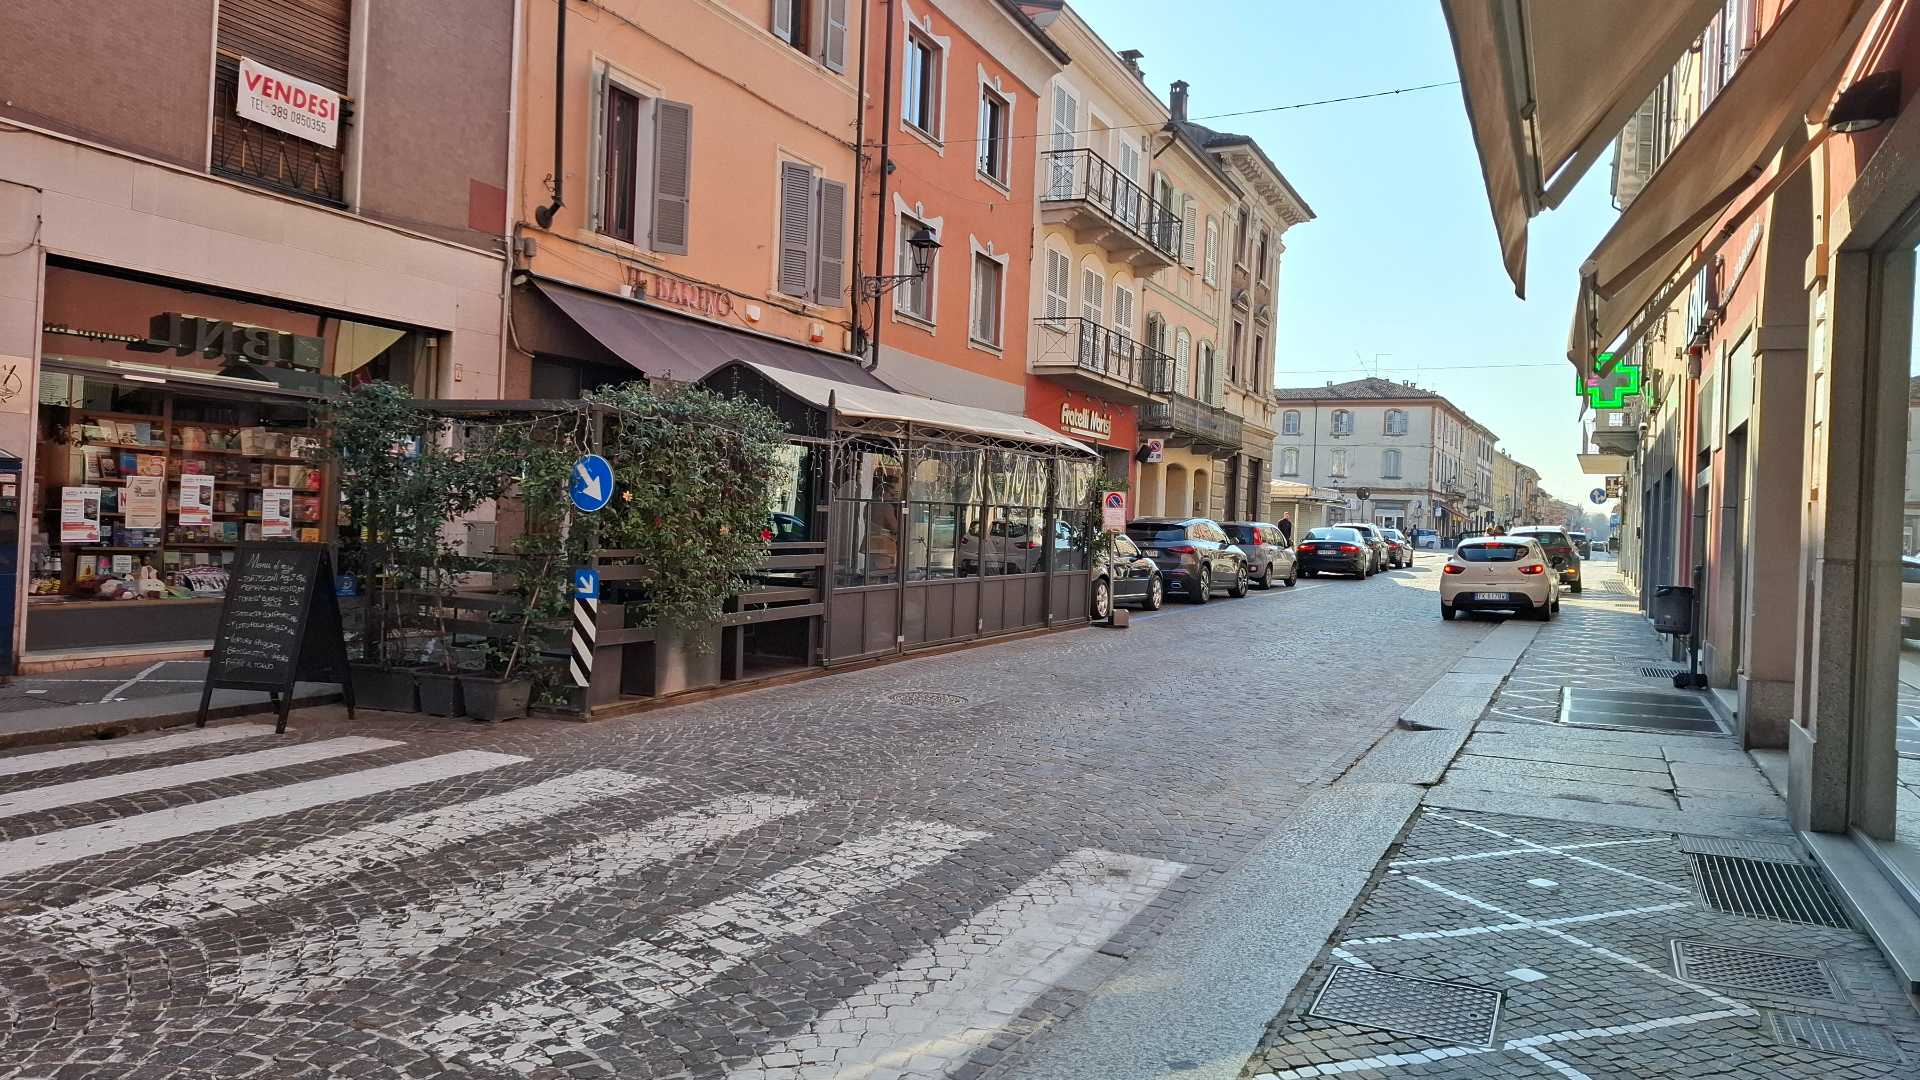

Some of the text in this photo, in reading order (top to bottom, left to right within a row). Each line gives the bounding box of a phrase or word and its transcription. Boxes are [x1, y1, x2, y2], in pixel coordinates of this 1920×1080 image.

[244, 70, 336, 121] VENDESI
[271, 104, 289, 120] 389
[290, 111, 327, 134] 0850355
[1061, 403, 1090, 429] Fratelli
